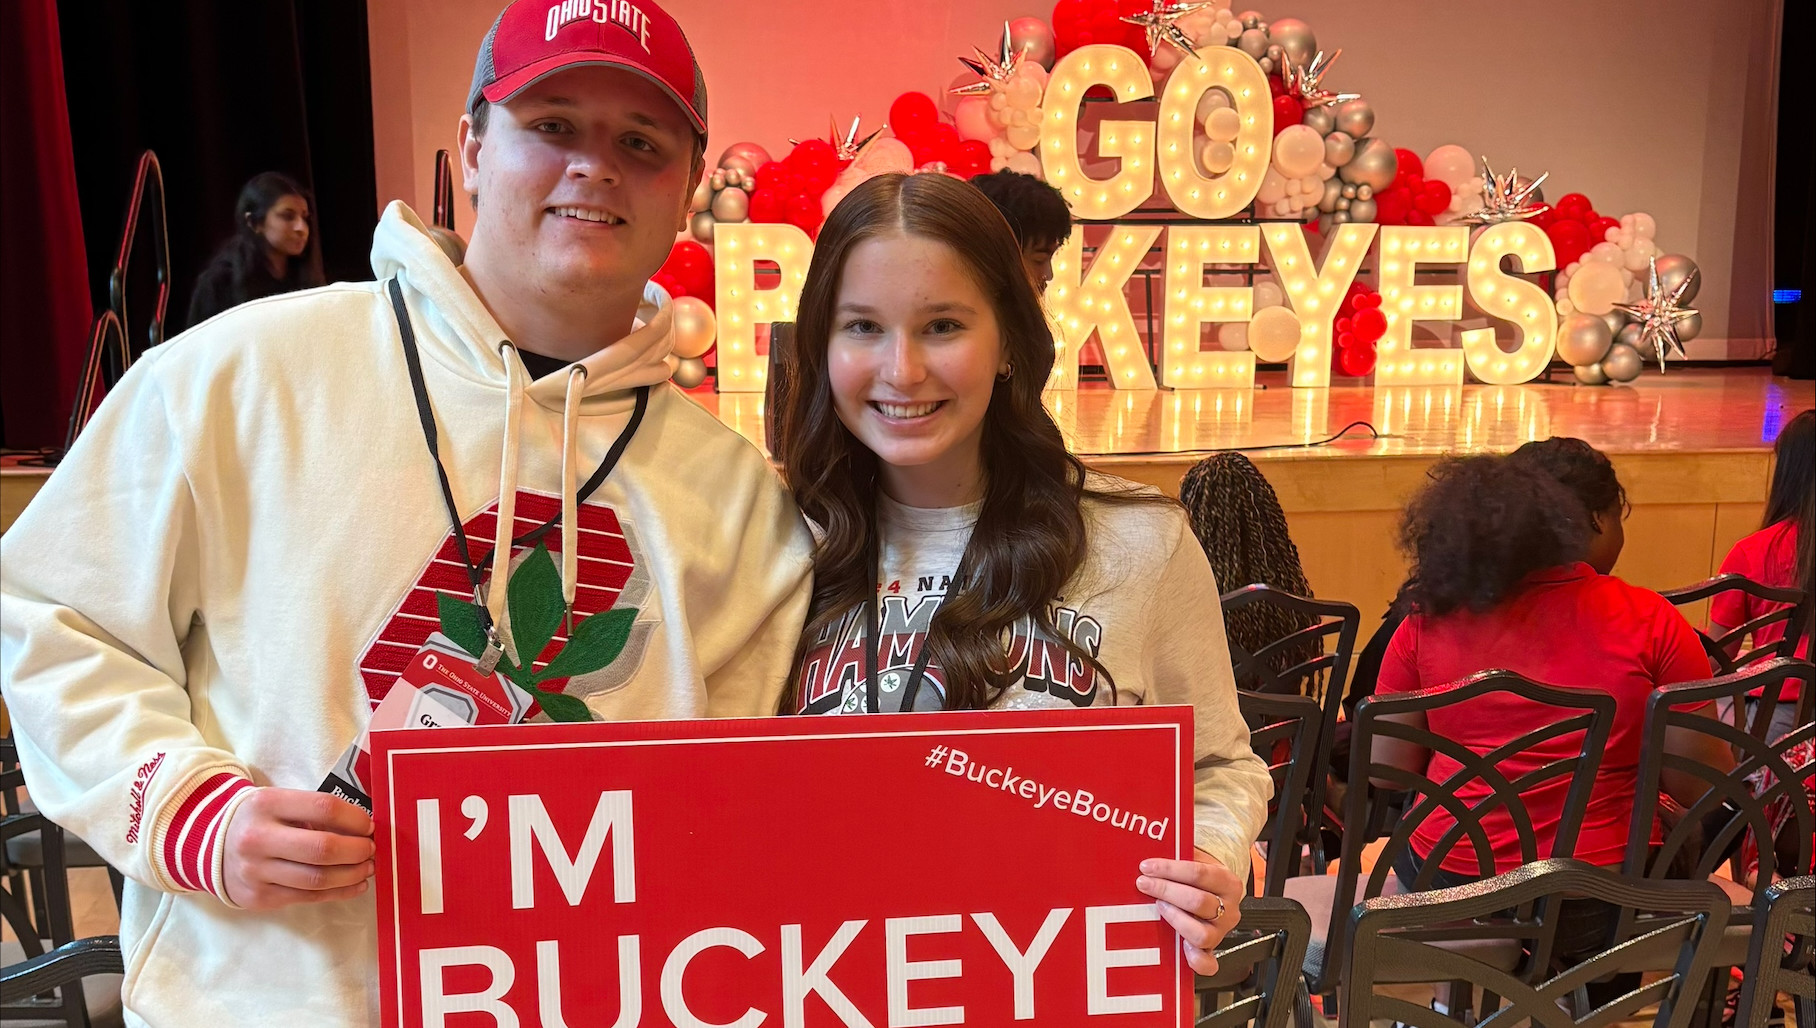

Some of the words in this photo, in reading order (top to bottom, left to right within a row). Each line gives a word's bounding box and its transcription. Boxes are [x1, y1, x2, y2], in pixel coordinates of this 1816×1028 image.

[545, 0, 591, 41] OHIO
[592, 0, 651, 55] STATE
[1040, 44, 1274, 220] GO
[713, 221, 1557, 393] BKEYES
[437, 663, 449, 675] THE
[449, 671, 464, 686] OHIO
[463, 681, 479, 695] STATE
[479, 692, 512, 717] UNIVERSITY
[133, 780, 145, 791] &
[138, 752, 166, 779] Ness
[924, 744, 1169, 841] #BuckeyeBound
[126, 787, 142, 843] Mitchell
[419, 903, 1165, 1028] BUCKEYE
